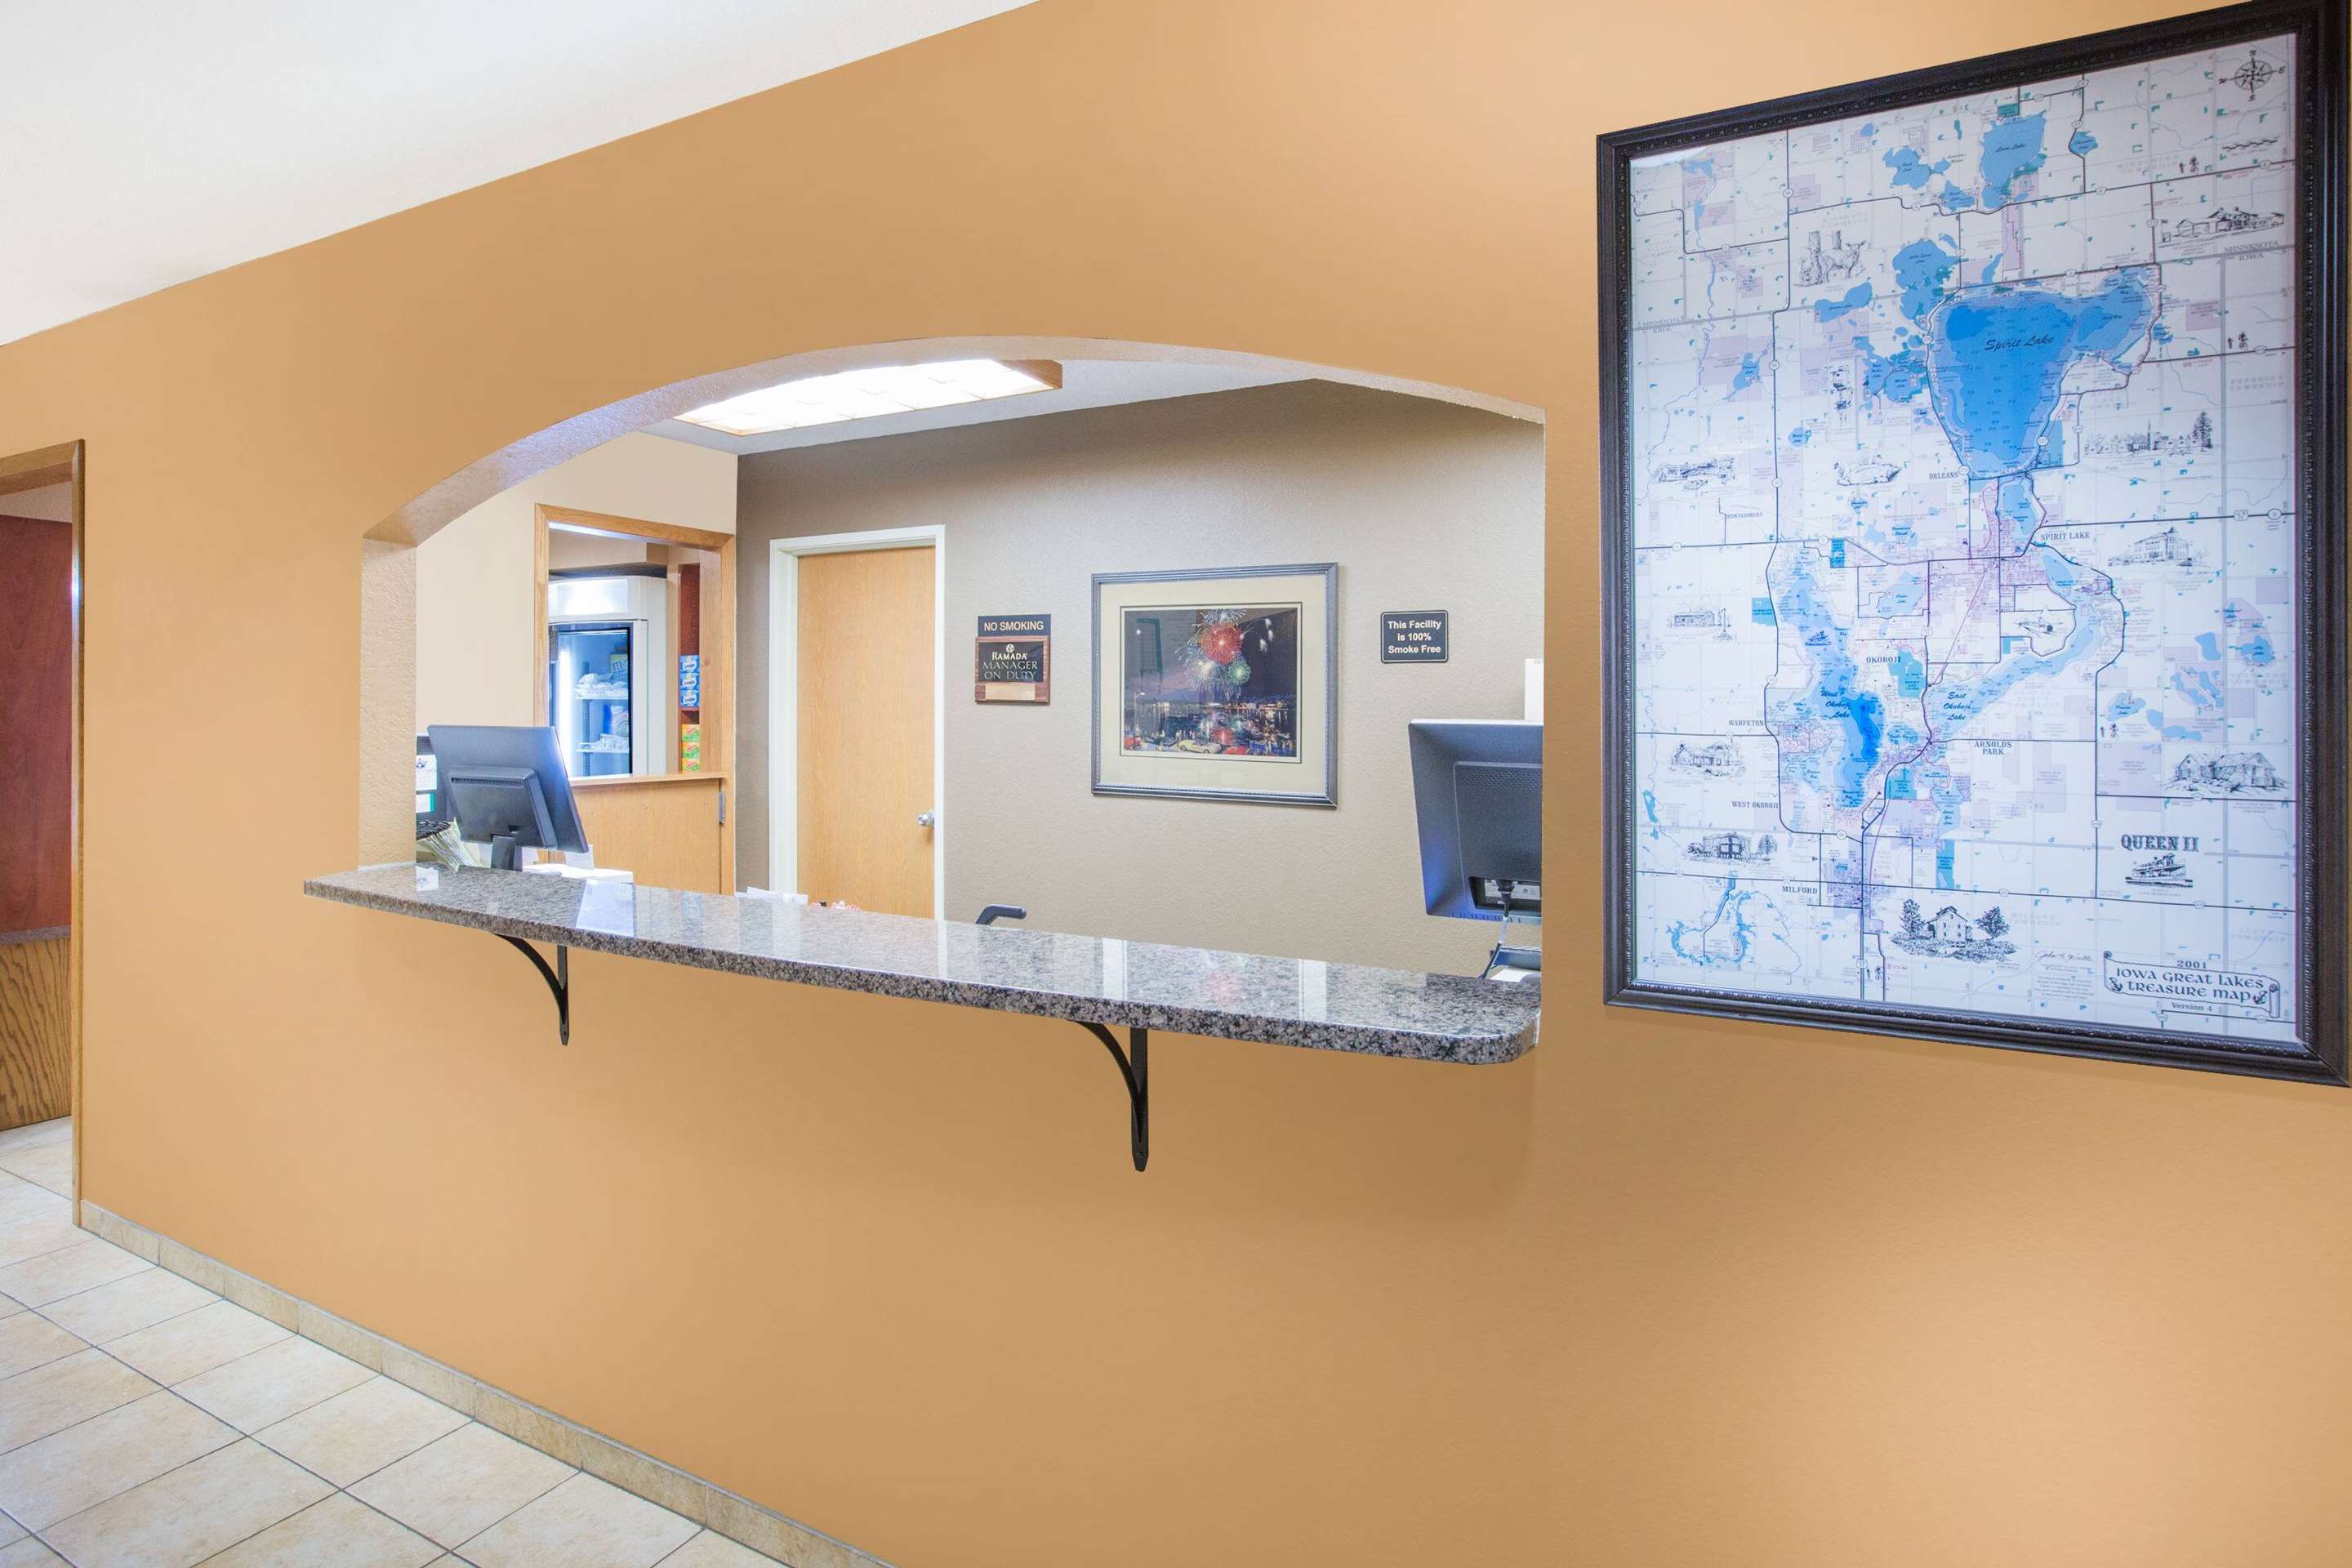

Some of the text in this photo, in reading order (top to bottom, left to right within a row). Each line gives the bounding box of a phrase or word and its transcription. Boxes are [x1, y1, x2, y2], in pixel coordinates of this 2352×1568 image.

[2023, 334, 2054, 346] Lake
[1929, 471, 1958, 479] ORLEANS
[2041, 532, 2090, 541] SPIRIT LAKE
[984, 621, 1044, 631] NO SMOKING
[1388, 620, 1441, 630] This Facility
[1408, 632, 1432, 641] 100%
[1388, 644, 1441, 654] Smoke Free
[991, 652, 1027, 661] RAMADA
[982, 661, 1038, 670] MANAGER
[983, 670, 1036, 680] ON DUTY
[2121, 834, 2199, 852] QUEEN II
[1782, 886, 1818, 894] MILFORD
[2176, 960, 2207, 969] 2001
[2117, 968, 2265, 989] IOWA GREAT LAKES
[2127, 981, 2251, 1004] TREASURE MAP
[2172, 1002, 2204, 1011] Version
